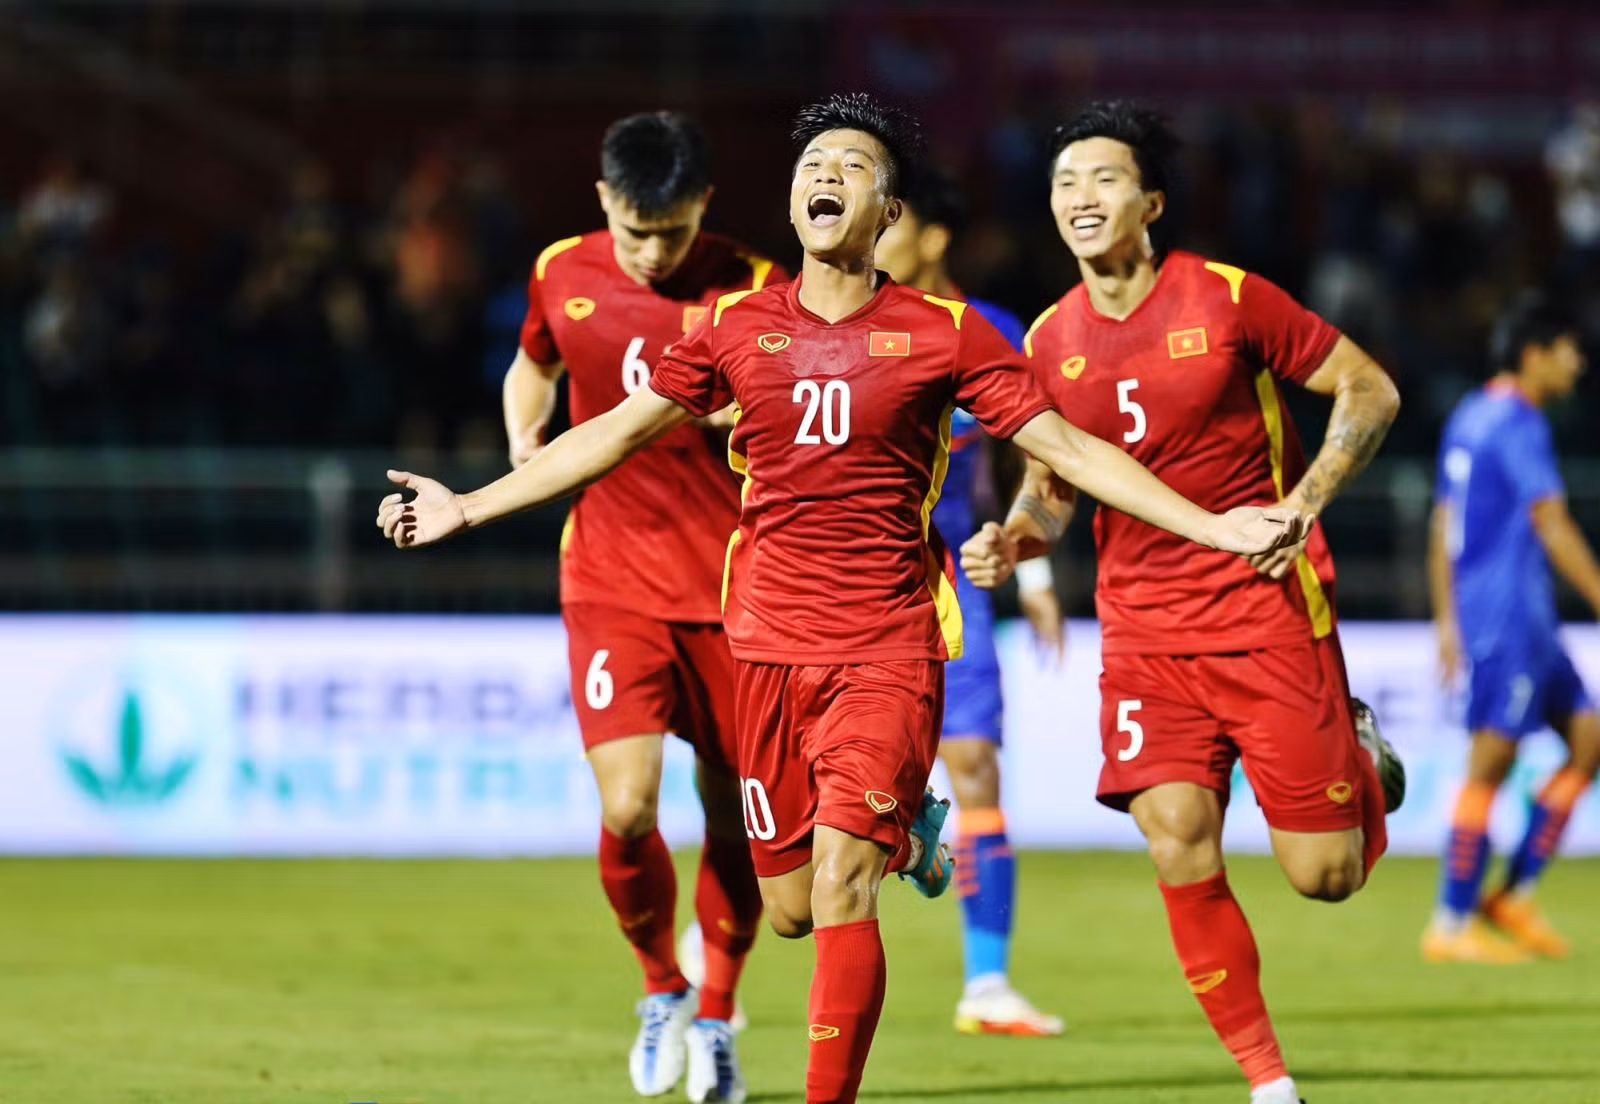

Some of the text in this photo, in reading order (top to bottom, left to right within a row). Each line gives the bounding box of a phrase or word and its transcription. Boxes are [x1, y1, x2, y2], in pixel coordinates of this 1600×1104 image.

[621, 337, 651, 396] 6
[792, 379, 851, 446] 20
[1116, 378, 1147, 444] 5
[585, 649, 614, 710] 6
[1117, 699, 1144, 762] 5
